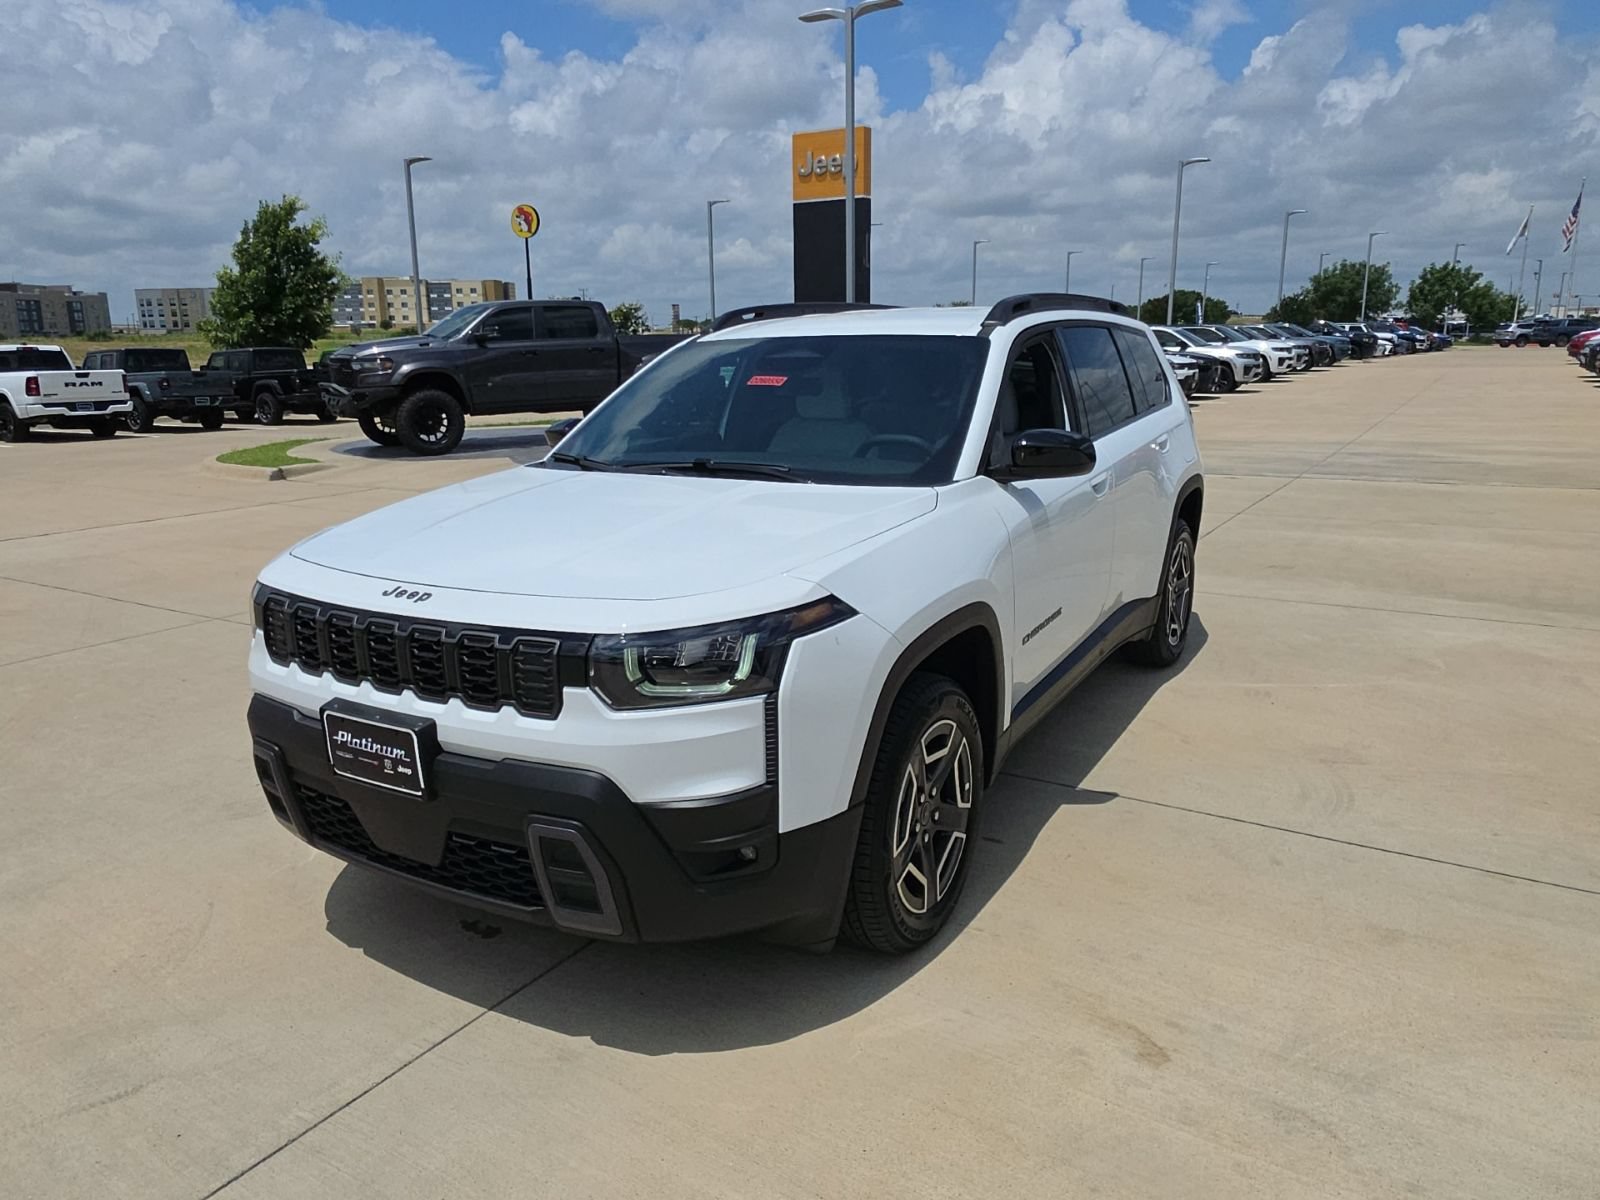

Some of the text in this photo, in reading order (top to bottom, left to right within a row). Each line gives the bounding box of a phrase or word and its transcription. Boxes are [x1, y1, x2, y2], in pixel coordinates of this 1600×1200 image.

[798, 150, 858, 185] Jee
[382, 586, 433, 603] Jeep
[332, 730, 411, 762] Platinum
